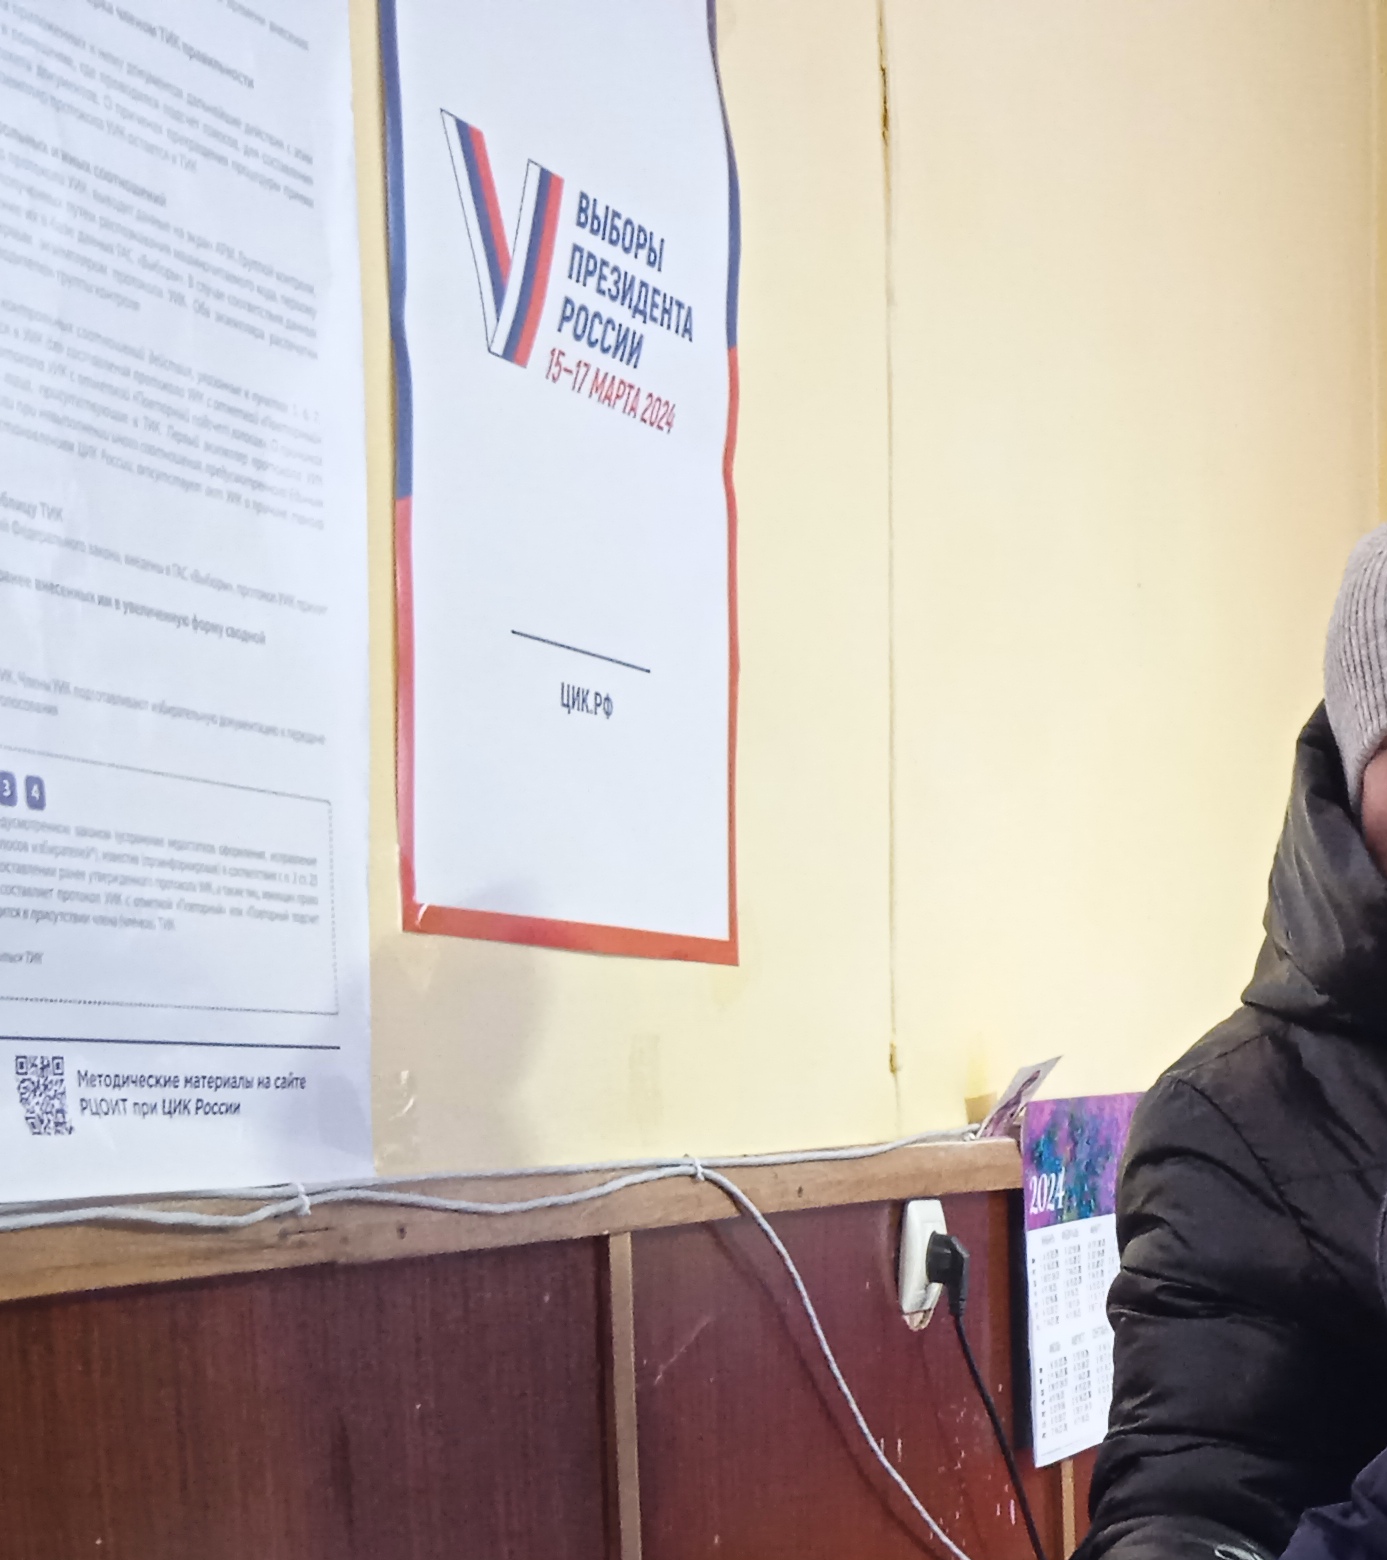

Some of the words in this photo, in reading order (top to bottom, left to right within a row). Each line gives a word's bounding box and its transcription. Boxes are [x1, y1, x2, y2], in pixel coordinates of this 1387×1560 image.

[576, 190, 665, 273] ВЫБОРЫ
[567, 243, 694, 343] ПРЕЗИДЕНТА
[557, 296, 645, 370] РОССИИ
[588, 367, 641, 419] МАРТА
[640, 392, 676, 434] 2024
[560, 681, 614, 720] ЦИК.РФ
[77, 1070, 180, 1091] Методические
[183, 1075, 255, 1092] материалы
[257, 1076, 271, 1090] на
[274, 1071, 307, 1090] сайте
[133, 1102, 158, 1119] при
[162, 1099, 192, 1118] ЦИК
[195, 1099, 241, 1116] России
[1029, 1166, 1066, 1215] 2024
